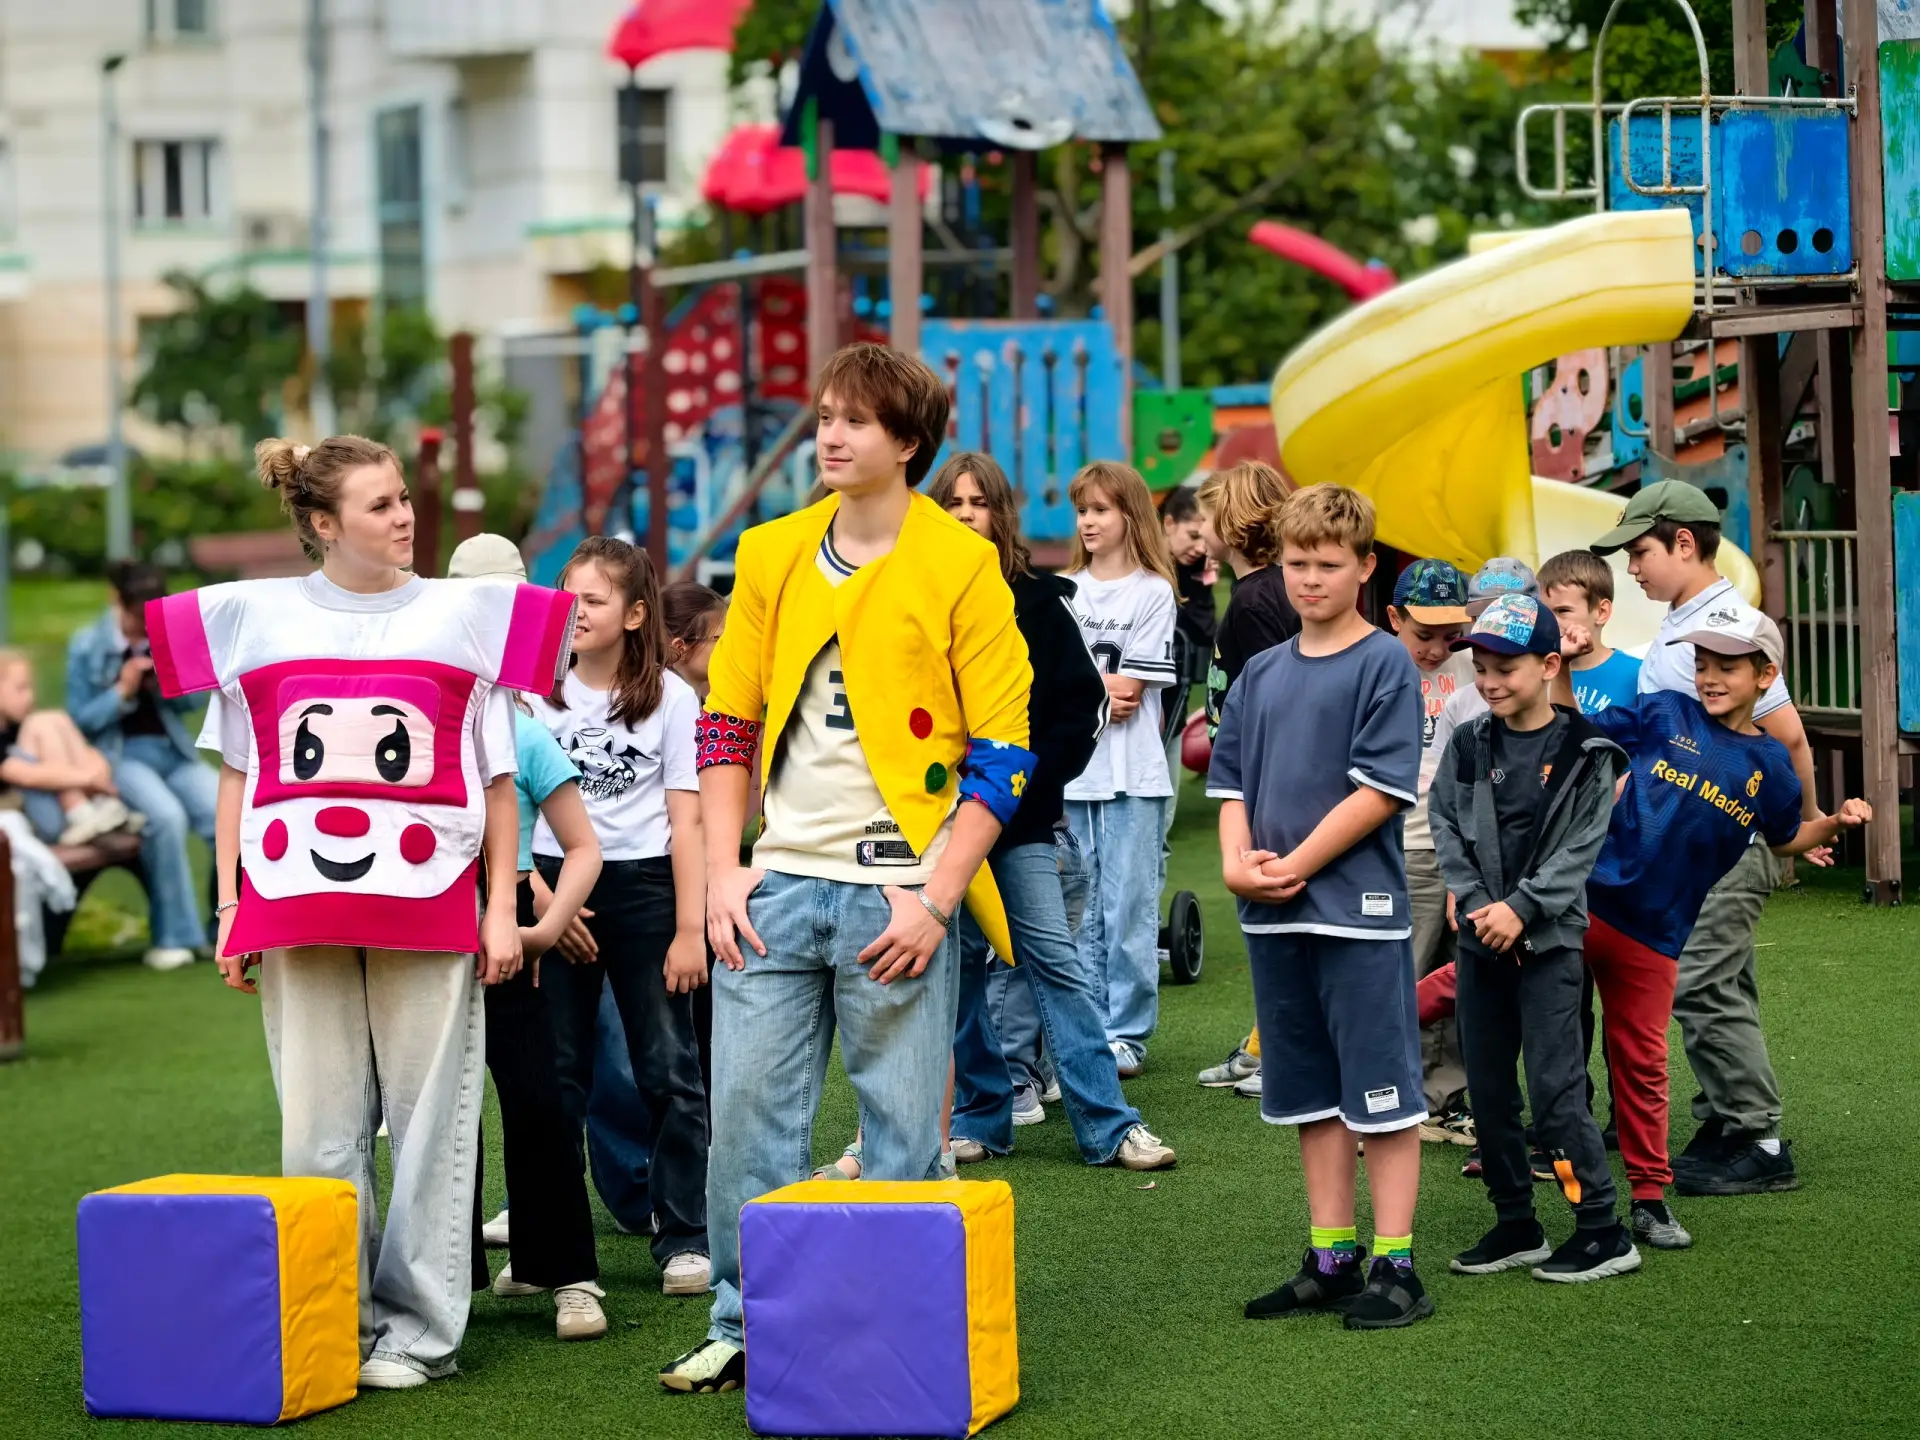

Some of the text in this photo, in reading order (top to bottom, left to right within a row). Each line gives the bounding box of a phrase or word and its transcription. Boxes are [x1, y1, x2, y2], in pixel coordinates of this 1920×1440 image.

[1105, 618, 1119, 631] the
[1437, 673, 1455, 695] ON
[1674, 734, 1697, 748] 1902
[1651, 759, 1756, 828] Real Madrid
[865, 823, 899, 835] BUCKS
